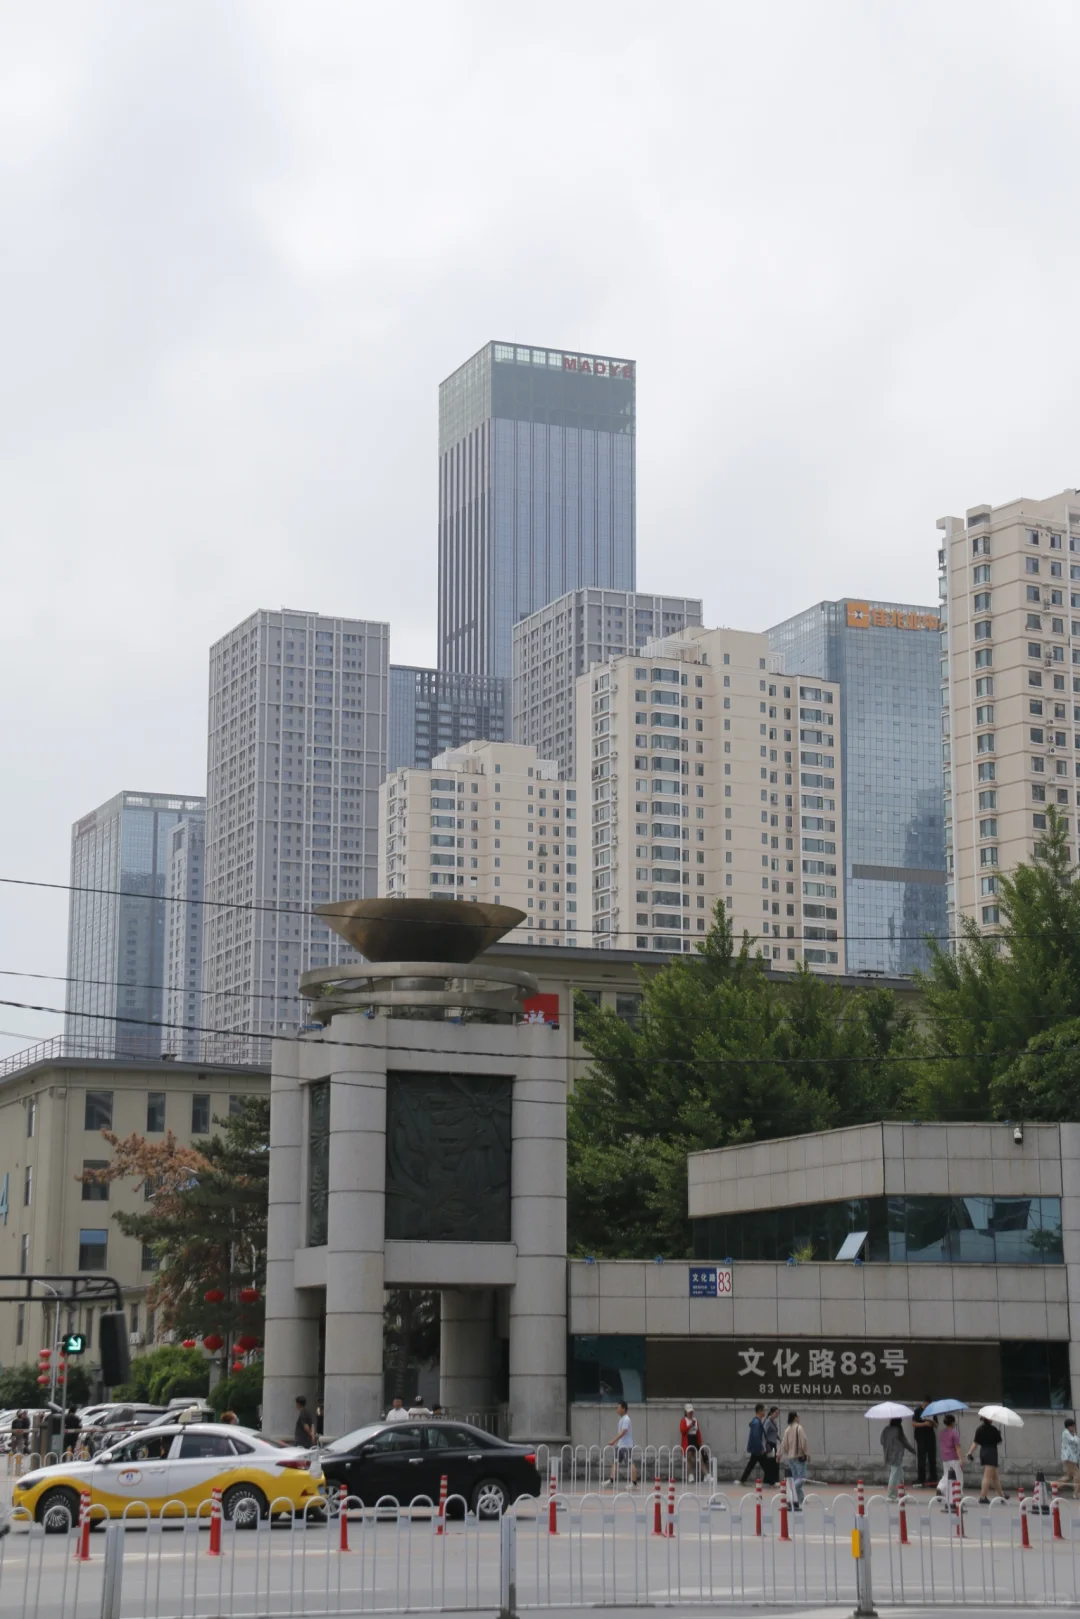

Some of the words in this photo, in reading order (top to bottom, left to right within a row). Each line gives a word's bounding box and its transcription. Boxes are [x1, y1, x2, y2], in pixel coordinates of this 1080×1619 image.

[563, 357, 632, 379] MAOYE
[872, 608, 942, 632] 佳兆业中
[692, 1273, 716, 1282] 文化路
[718, 1271, 731, 1292] 83
[738, 1348, 908, 1378] 文化路83号
[759, 1384, 774, 1394] 83
[780, 1384, 842, 1395] WENHUA
[852, 1384, 892, 1395] ROAD
